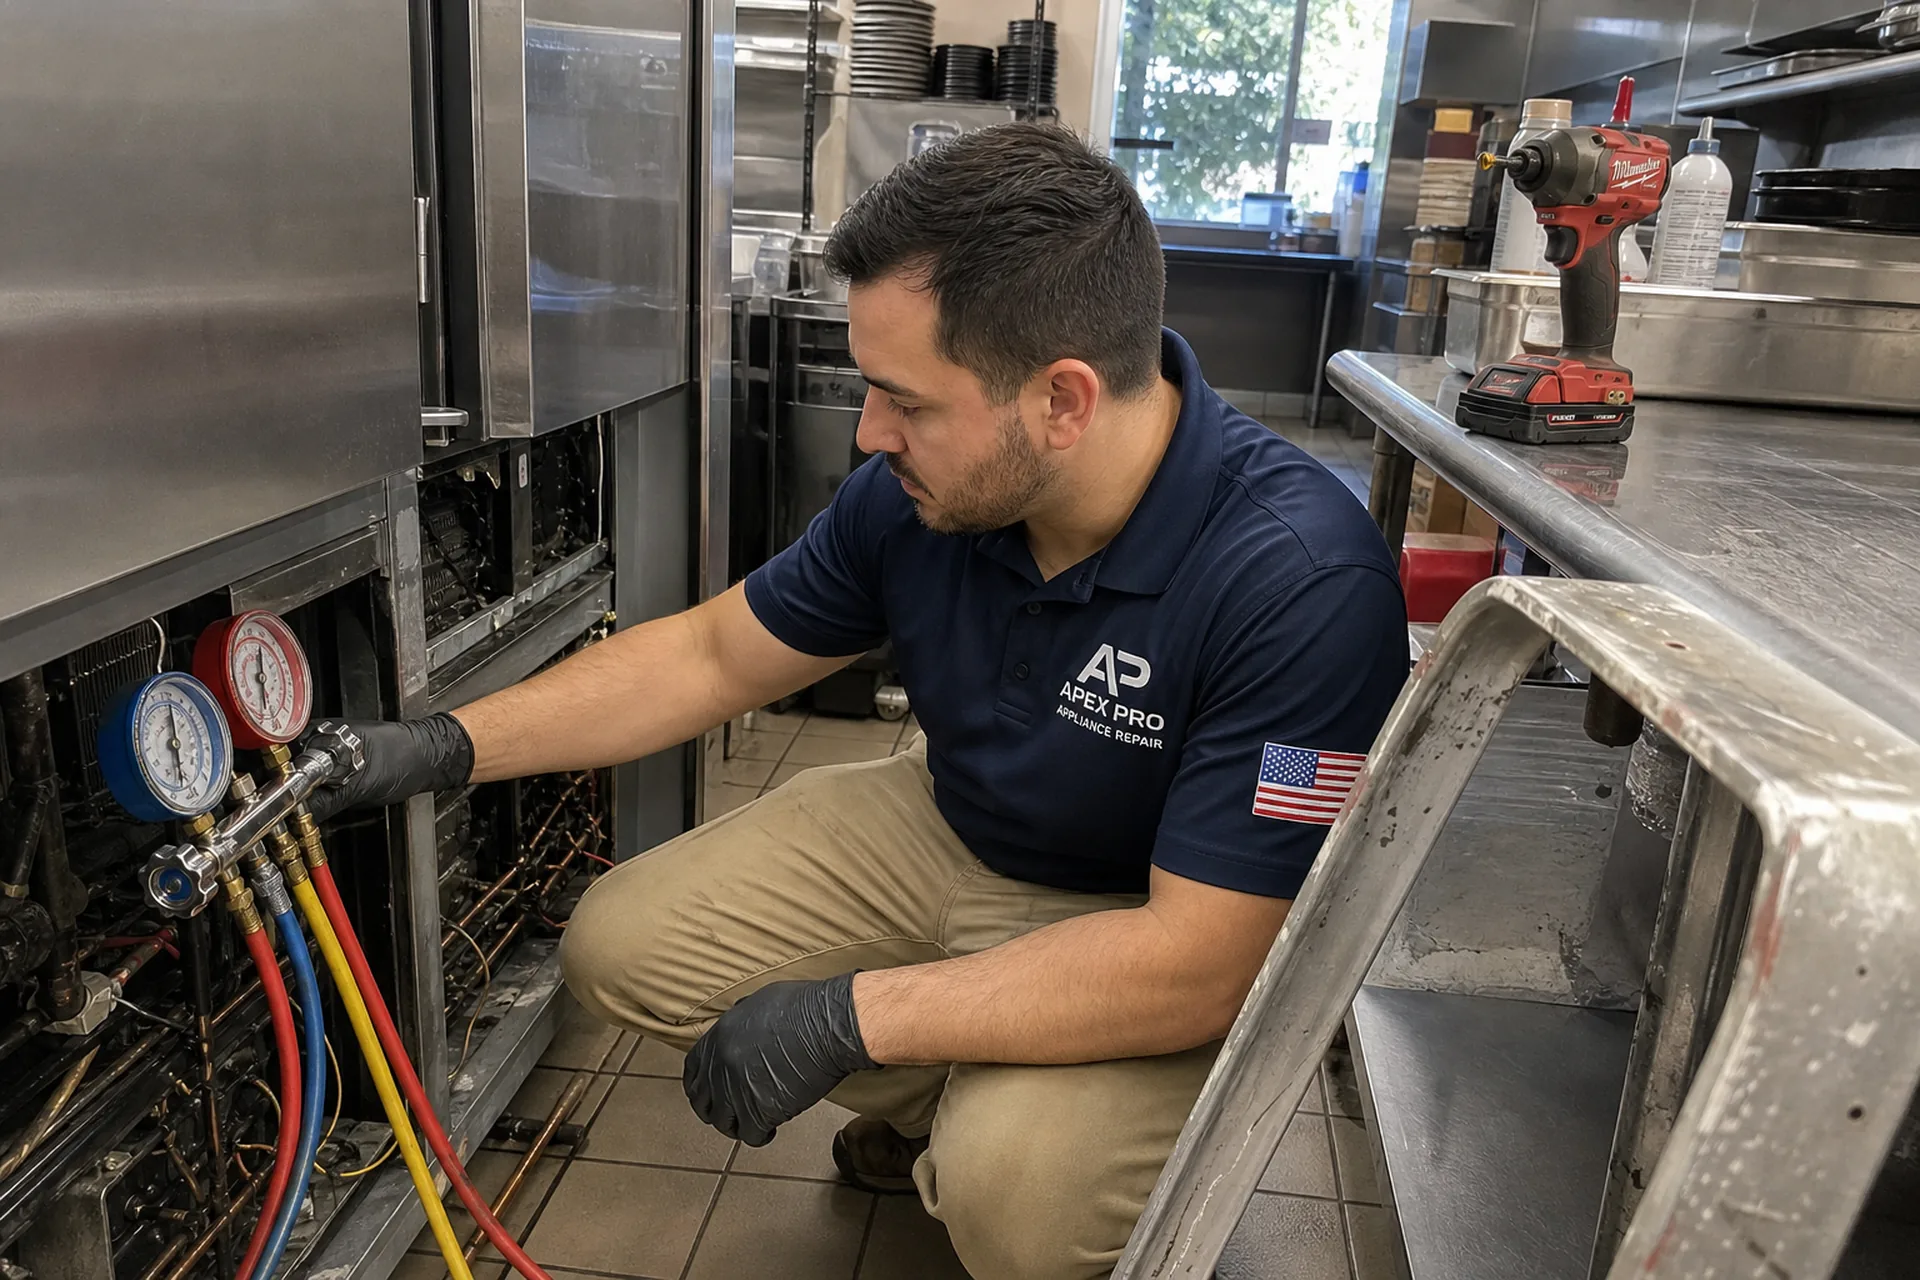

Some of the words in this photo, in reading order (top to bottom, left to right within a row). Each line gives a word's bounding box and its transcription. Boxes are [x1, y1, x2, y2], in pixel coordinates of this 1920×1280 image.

[1076, 643, 1151, 697] AP
[1056, 704, 1112, 738] APPLIANCE
[1115, 729, 1163, 749] REPAIR
[1059, 681, 1110, 717] APEX
[1113, 703, 1165, 731] PRO
